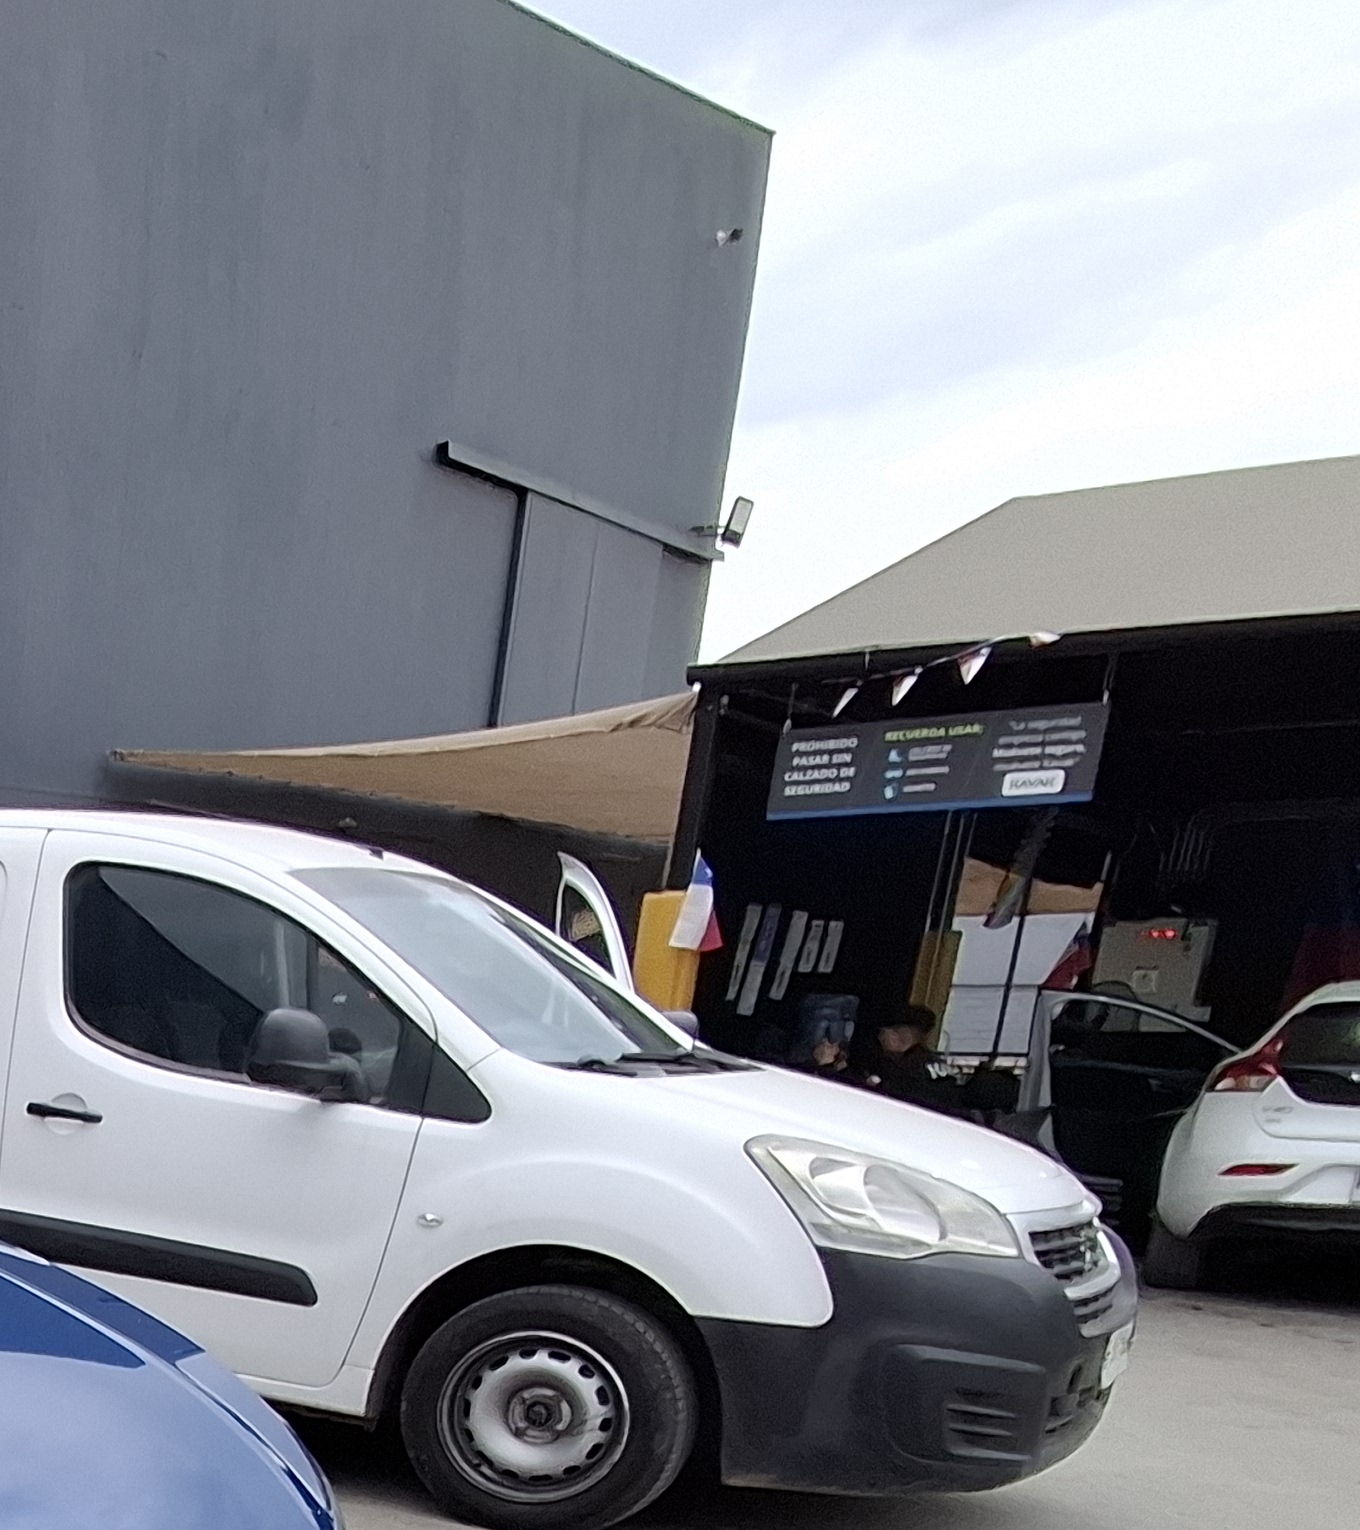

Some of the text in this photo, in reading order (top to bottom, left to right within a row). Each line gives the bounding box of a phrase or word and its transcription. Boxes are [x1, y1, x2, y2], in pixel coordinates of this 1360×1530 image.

[791, 737, 858, 752] PROHIBIDO
[792, 753, 852, 767] PASAR SIN
[784, 766, 856, 782] CALZADO DE
[784, 782, 851, 797] SEGURIDAD
